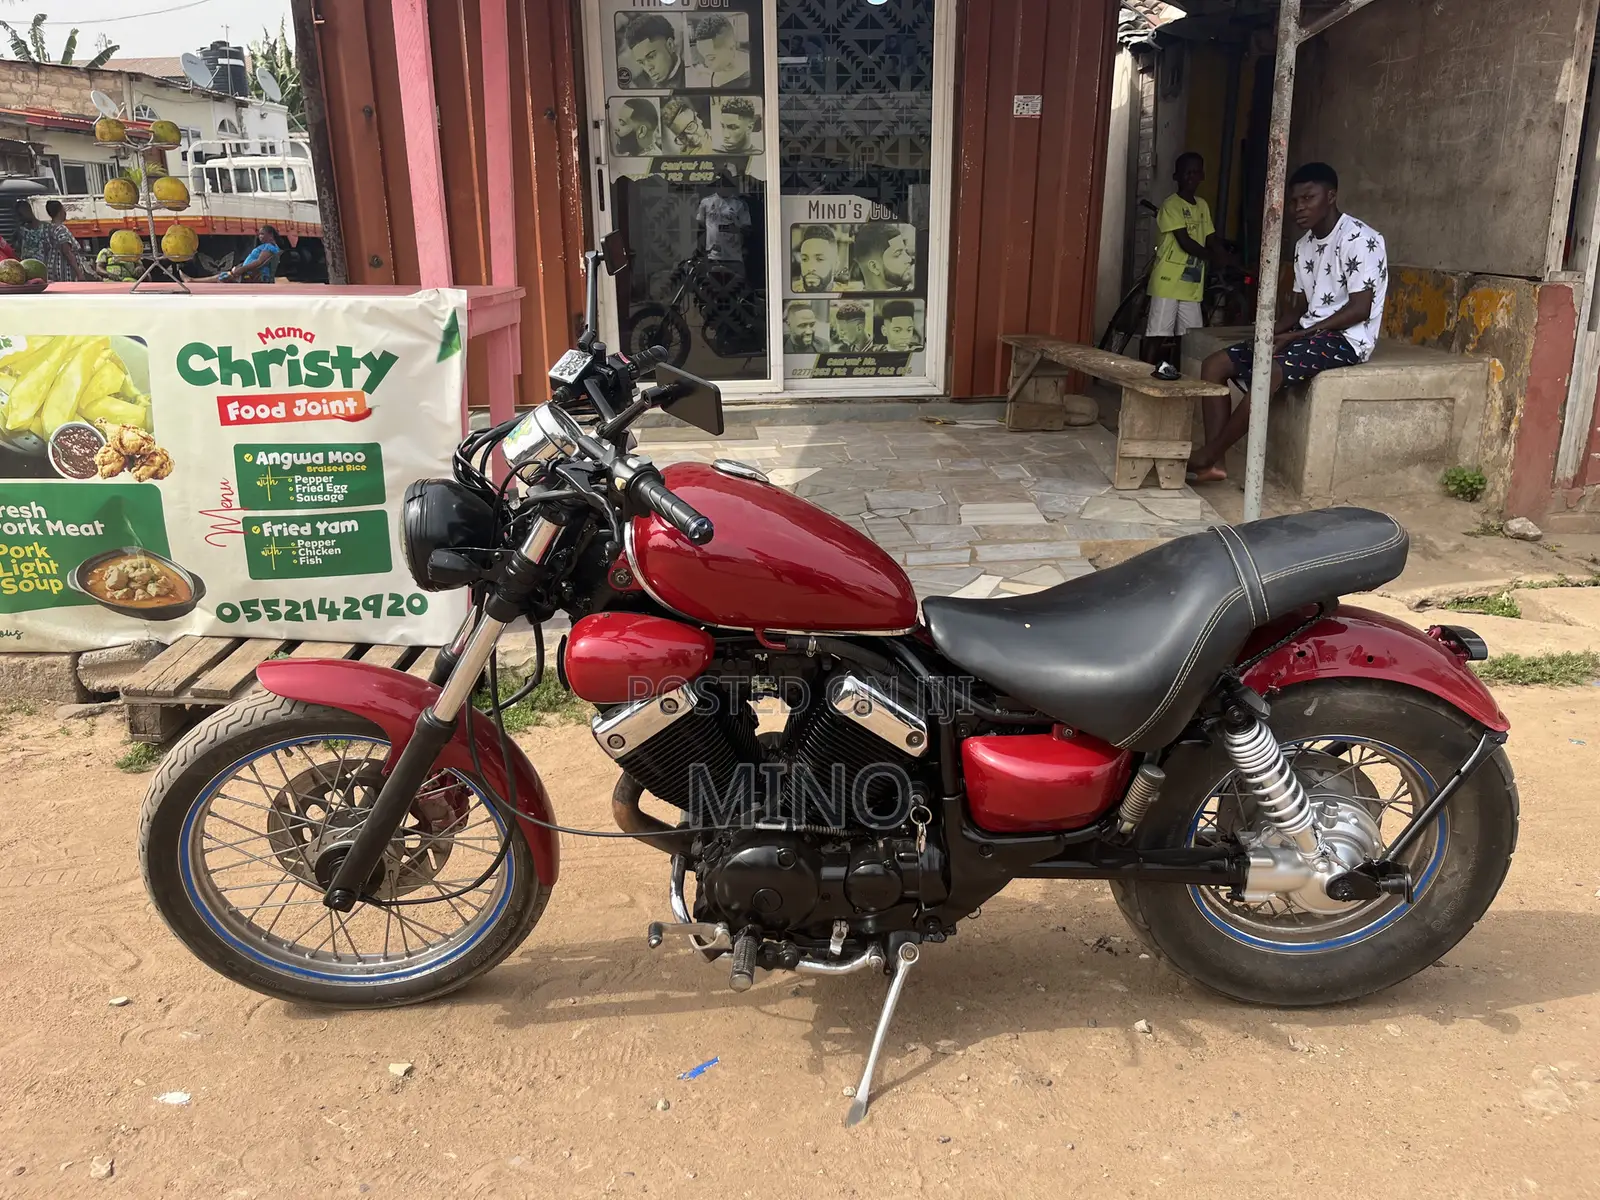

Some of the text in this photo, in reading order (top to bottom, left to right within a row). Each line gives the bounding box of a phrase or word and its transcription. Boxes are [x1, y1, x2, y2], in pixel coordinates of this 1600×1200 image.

[257, 326, 316, 345] Mama
[176, 342, 400, 395] Christy
[226, 397, 358, 421] Food Joint
[256, 451, 366, 470] Angwa Moo
[306, 464, 367, 473] Braised Rice
[294, 475, 334, 486] Pepper
[295, 483, 348, 494] Fried Egg
[296, 493, 345, 503] Sausage
[199, 477, 249, 547] Menu
[0, 518, 105, 536] ork Meat
[262, 520, 359, 537] Fried Yam
[297, 539, 336, 550] Pepper
[298, 547, 341, 556] Chicken
[0, 558, 59, 578] Light
[299, 556, 323, 565] Fish
[0, 577, 64, 595] Soup
[216, 592, 429, 623] 0552142920
